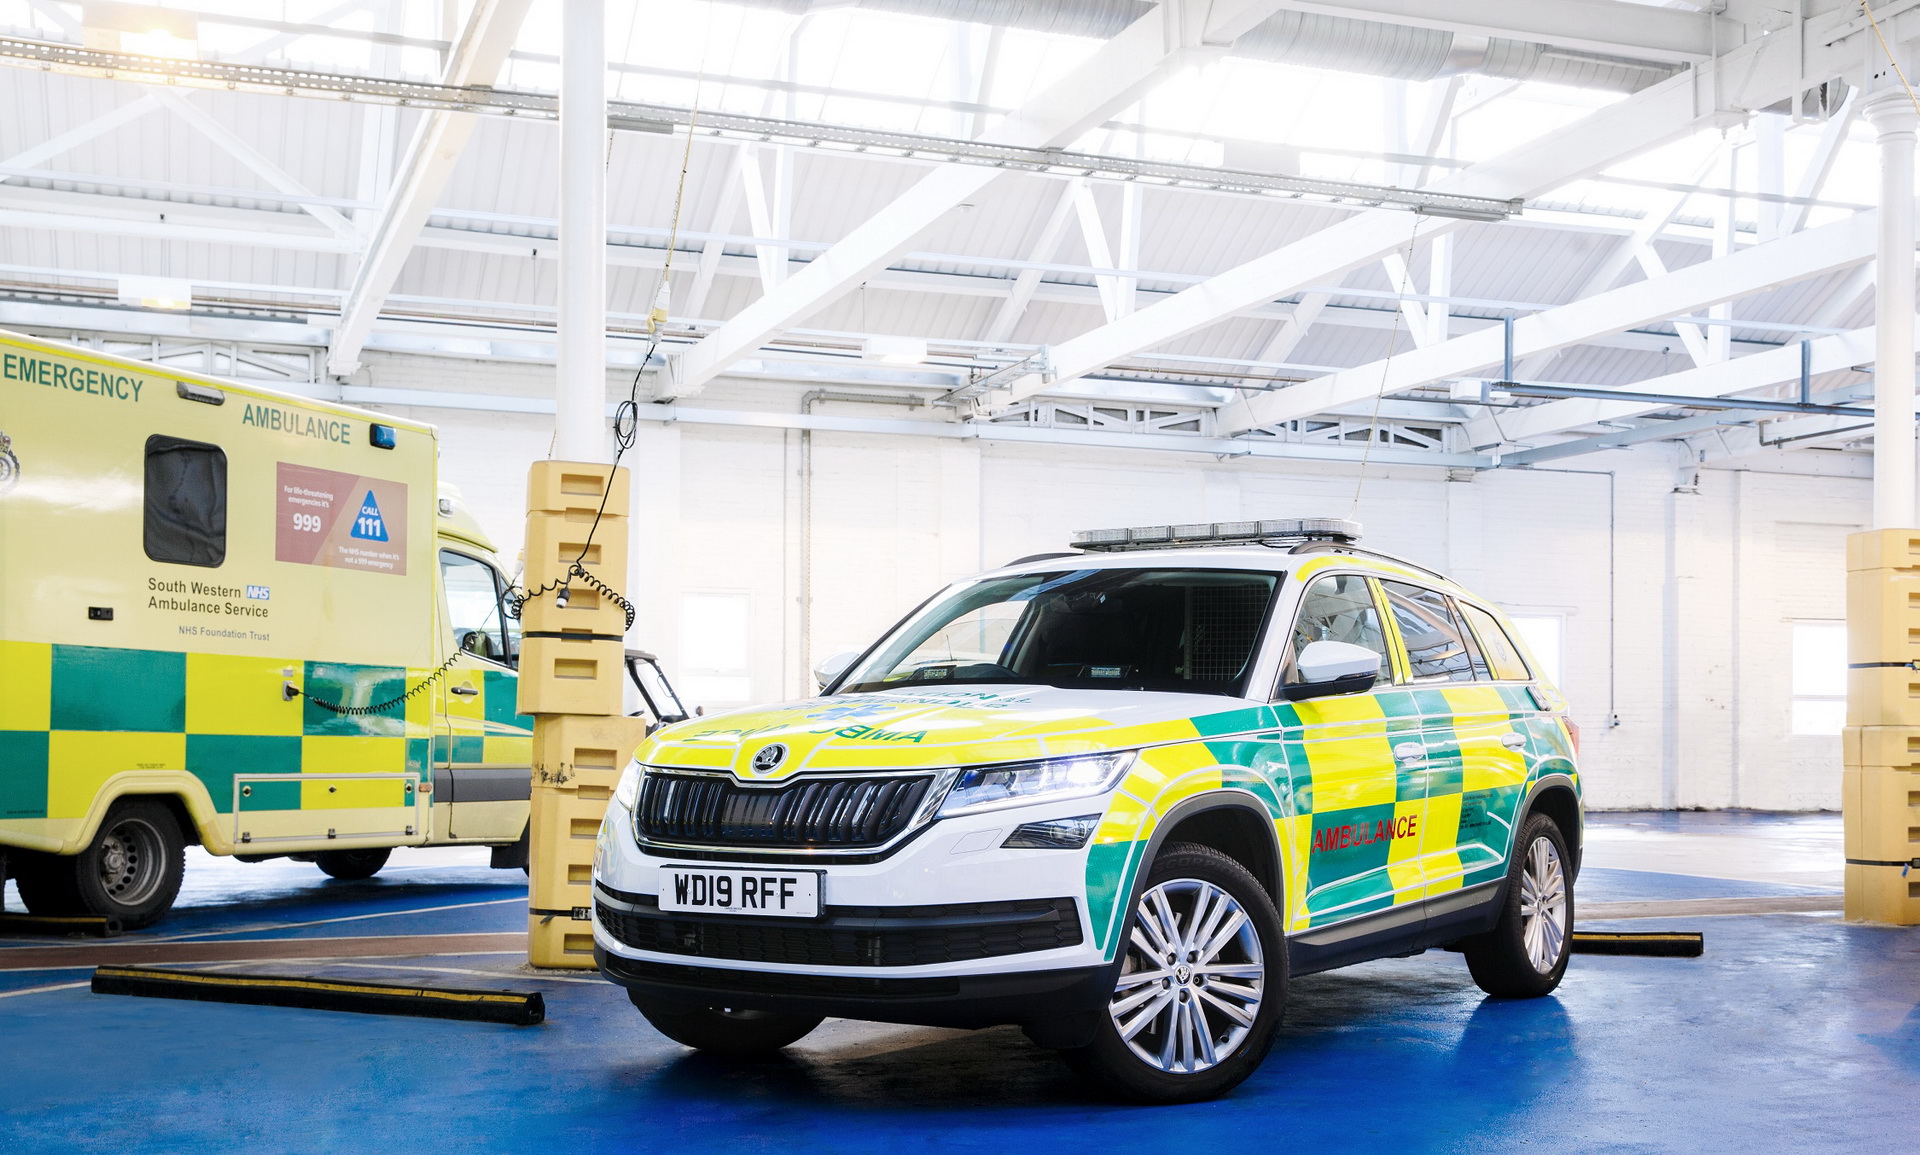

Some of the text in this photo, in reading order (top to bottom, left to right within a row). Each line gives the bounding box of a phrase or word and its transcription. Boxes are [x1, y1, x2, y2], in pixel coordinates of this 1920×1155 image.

[4, 353, 144, 402] EMERGENCY
[242, 403, 351, 445] AMBULANCE
[284, 485, 334, 501] For life-threatening
[288, 496, 330, 508] emergencies it's
[361, 506, 379, 517] CALL
[292, 512, 322, 533] 999
[357, 517, 382, 537] 111
[338, 546, 400, 561] The NHS number when it's
[344, 556, 354, 564] not
[358, 557, 367, 565] 999
[367, 559, 394, 569] emergency
[148, 577, 270, 600] South Western NHS
[148, 596, 269, 618] Ambulance Service
[179, 625, 270, 641] NHS Foundation Trust
[1311, 814, 1418, 854] AMBULANCE
[674, 873, 797, 910] WD19 RFF
